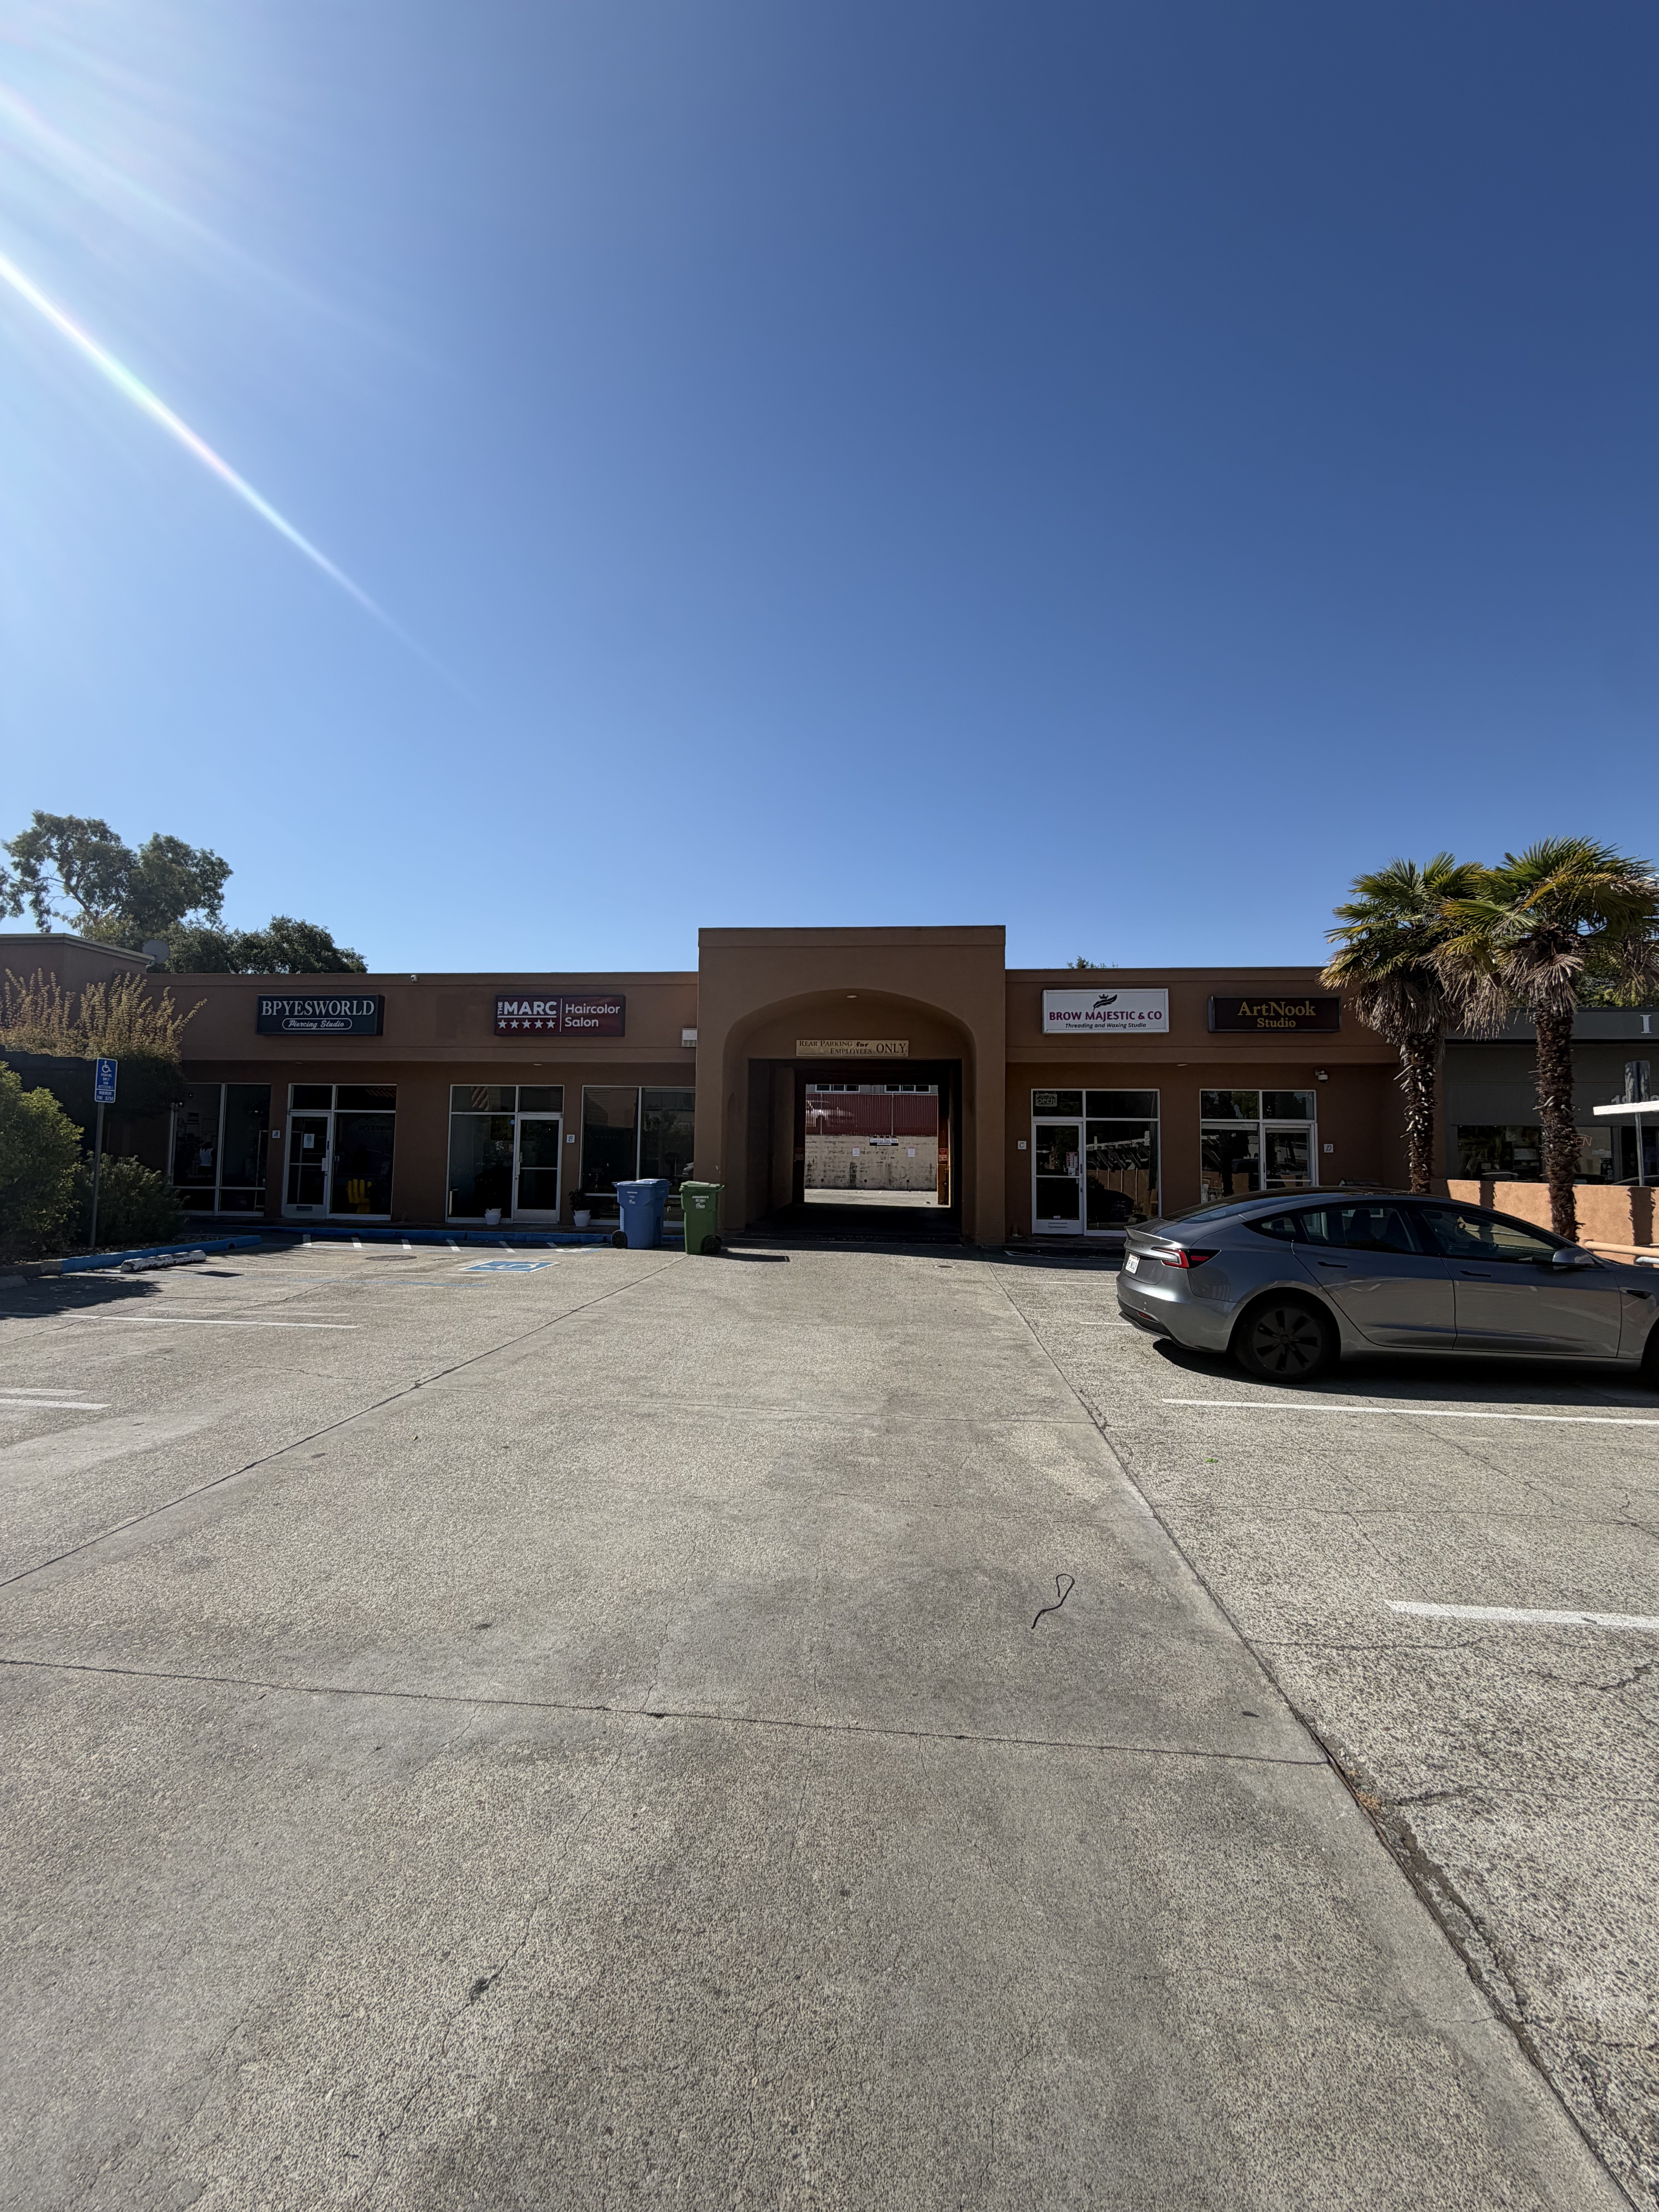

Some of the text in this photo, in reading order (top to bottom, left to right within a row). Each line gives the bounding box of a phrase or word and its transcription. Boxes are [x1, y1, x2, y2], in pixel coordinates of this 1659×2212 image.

[261, 1000, 374, 1015] BPYESWORLD
[504, 1001, 557, 1015] MARC
[565, 1003, 620, 1014] Haircolor
[1237, 1001, 1316, 1016] ArtNook
[565, 1017, 599, 1027] Salon
[1049, 1012, 1082, 1020] BROW
[1085, 1011, 1135, 1022] MAJESTIC
[1147, 1011, 1162, 1020] CO
[288, 1020, 318, 1029] Piercing
[1257, 1018, 1296, 1027] Studio
